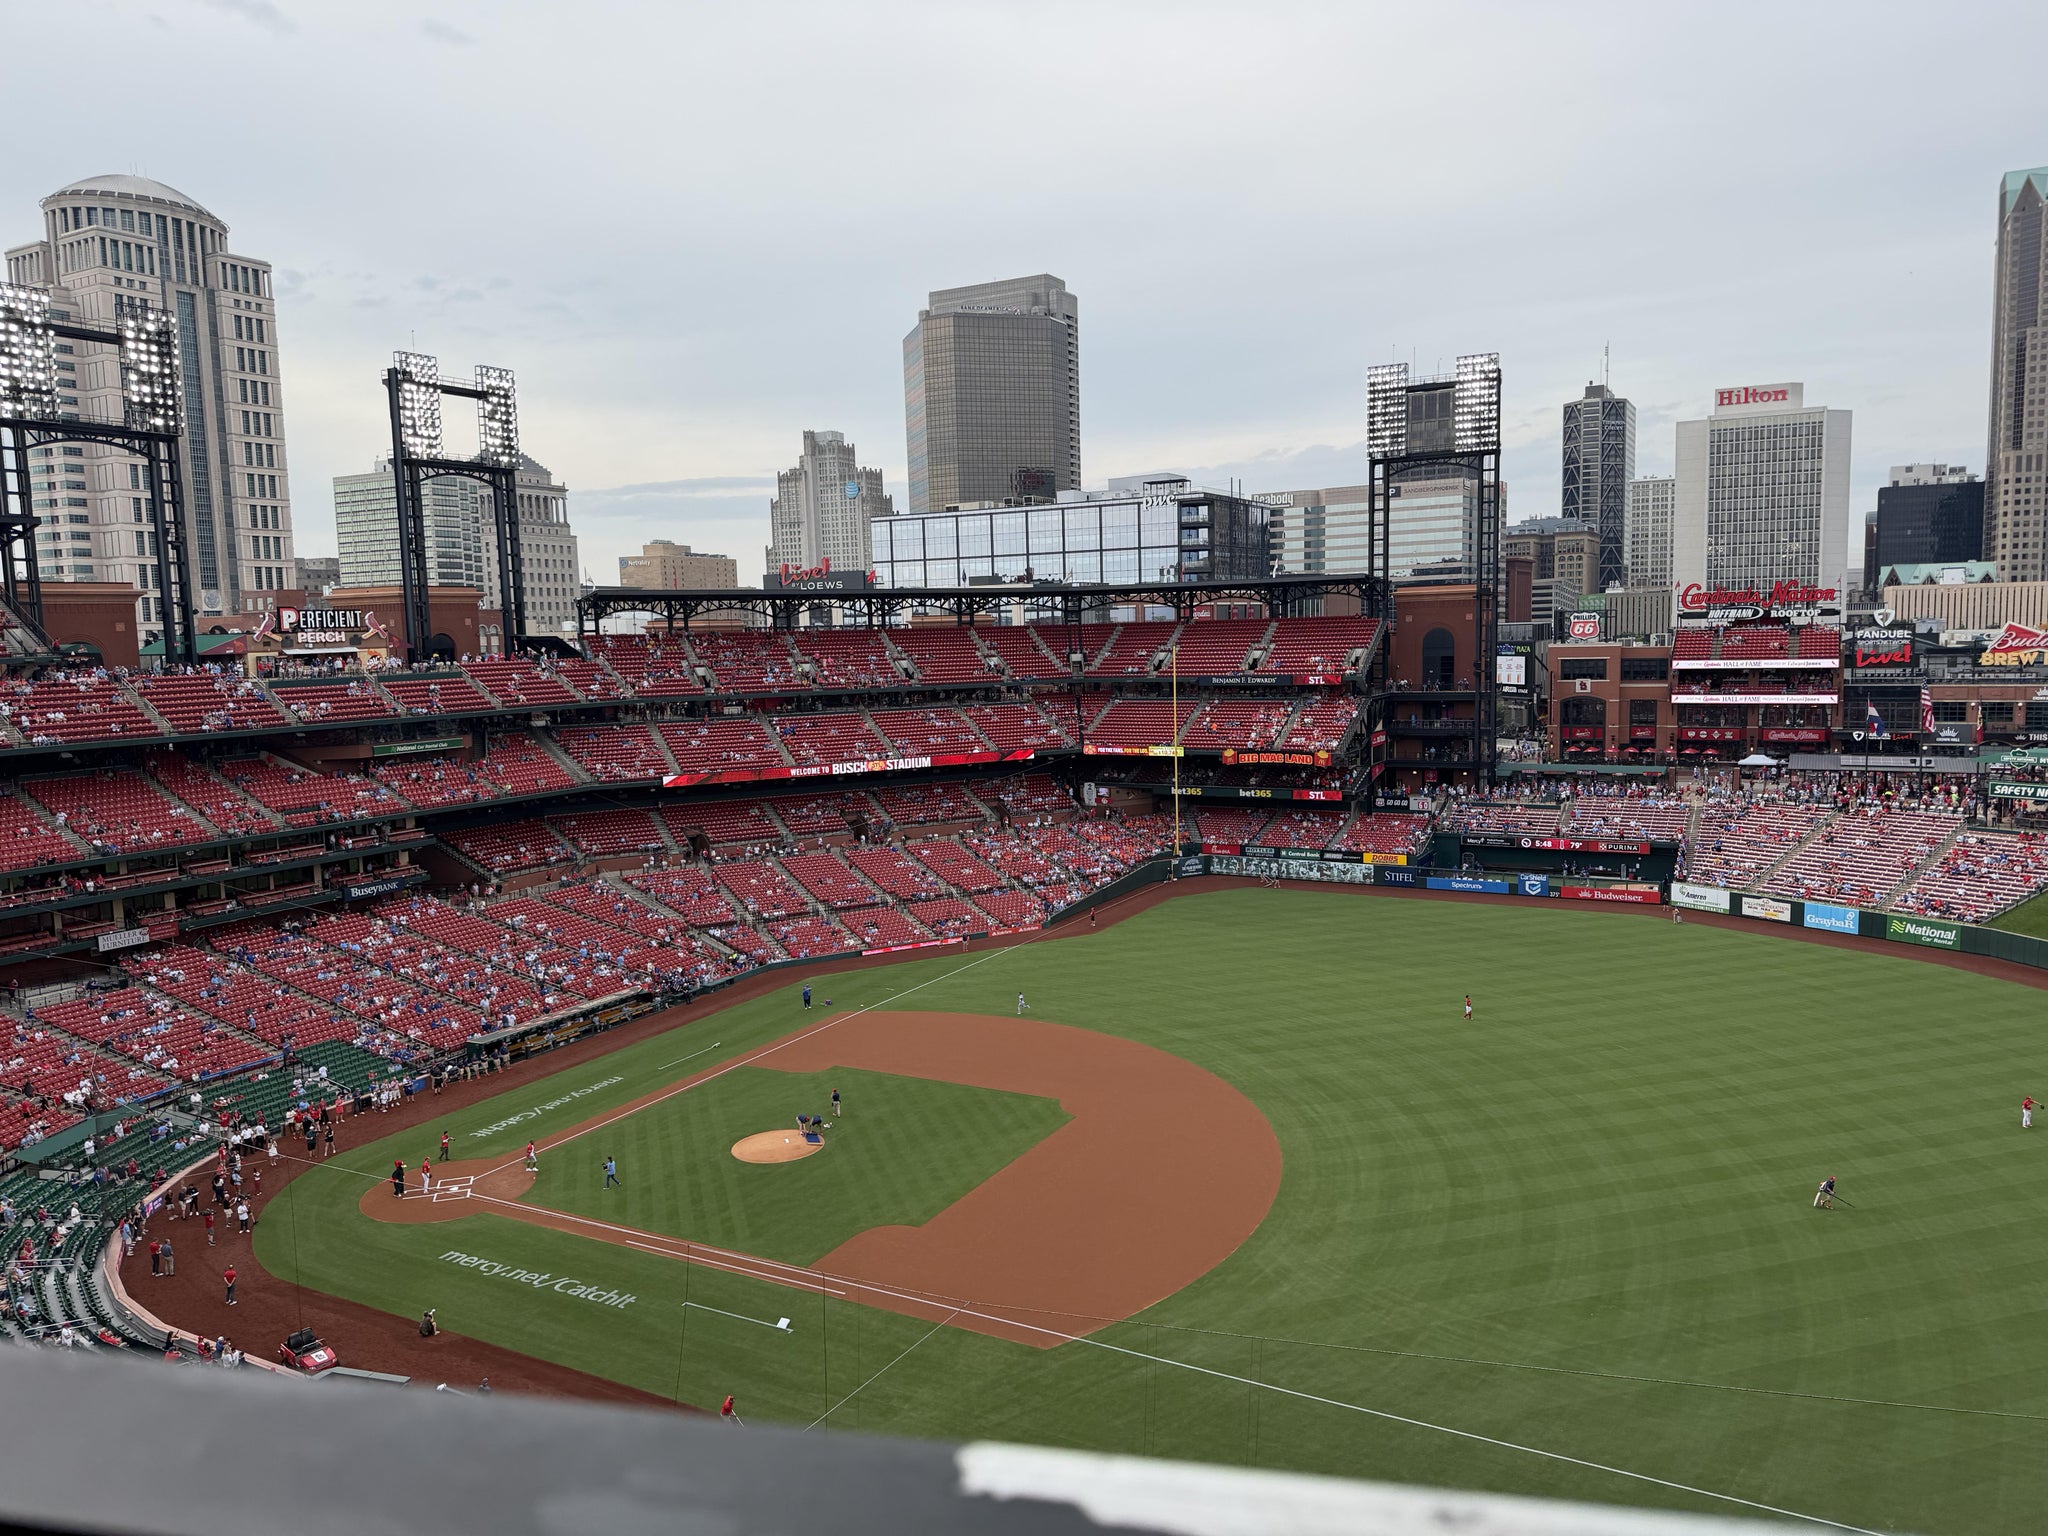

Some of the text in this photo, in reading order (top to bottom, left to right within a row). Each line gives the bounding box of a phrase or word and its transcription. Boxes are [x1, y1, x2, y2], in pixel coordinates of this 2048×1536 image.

[1718, 387, 1788, 406] Hilton
[1142, 494, 1177, 511] pwc
[1253, 492, 1294, 505] Peabody
[781, 557, 830, 586] Live!
[800, 581, 844, 590] LOEWS
[1681, 579, 1836, 610] Cardinals Nation
[1708, 608, 1822, 618] HOFFMANN ROOFTOP
[281, 608, 362, 631] PERFICIENT
[1574, 623, 1595, 634] 66
[1857, 630, 1912, 639] FANDUEL
[297, 631, 346, 643] PERCH
[1856, 645, 1911, 667] Live!
[1981, 650, 2039, 666] BREW
[1308, 676, 1325, 685] STL
[2029, 733, 2048, 741] THIS
[397, 744, 417, 752] National
[1239, 753, 1313, 765] BIG MAC LAND
[790, 767, 820, 776] WELCOME
[832, 761, 868, 775] BUSCH
[886, 756, 931, 771] STADIUM
[1171, 787, 1202, 795] bet365
[1240, 788, 1272, 798] bet365
[1308, 791, 1326, 800] STL
[1994, 785, 2035, 797] SAFETY
[1384, 871, 1415, 883] STIFEL
[1520, 874, 1547, 882] CarShield
[1451, 881, 1479, 890] Spectrum
[1593, 891, 1642, 902] Budweiser
[1685, 891, 1707, 901] Ameren
[102, 930, 138, 943] MUELLER
[1905, 923, 1957, 941] National
[103, 936, 146, 950] FURNITURE
[1934, 937, 1953, 945] Rental
